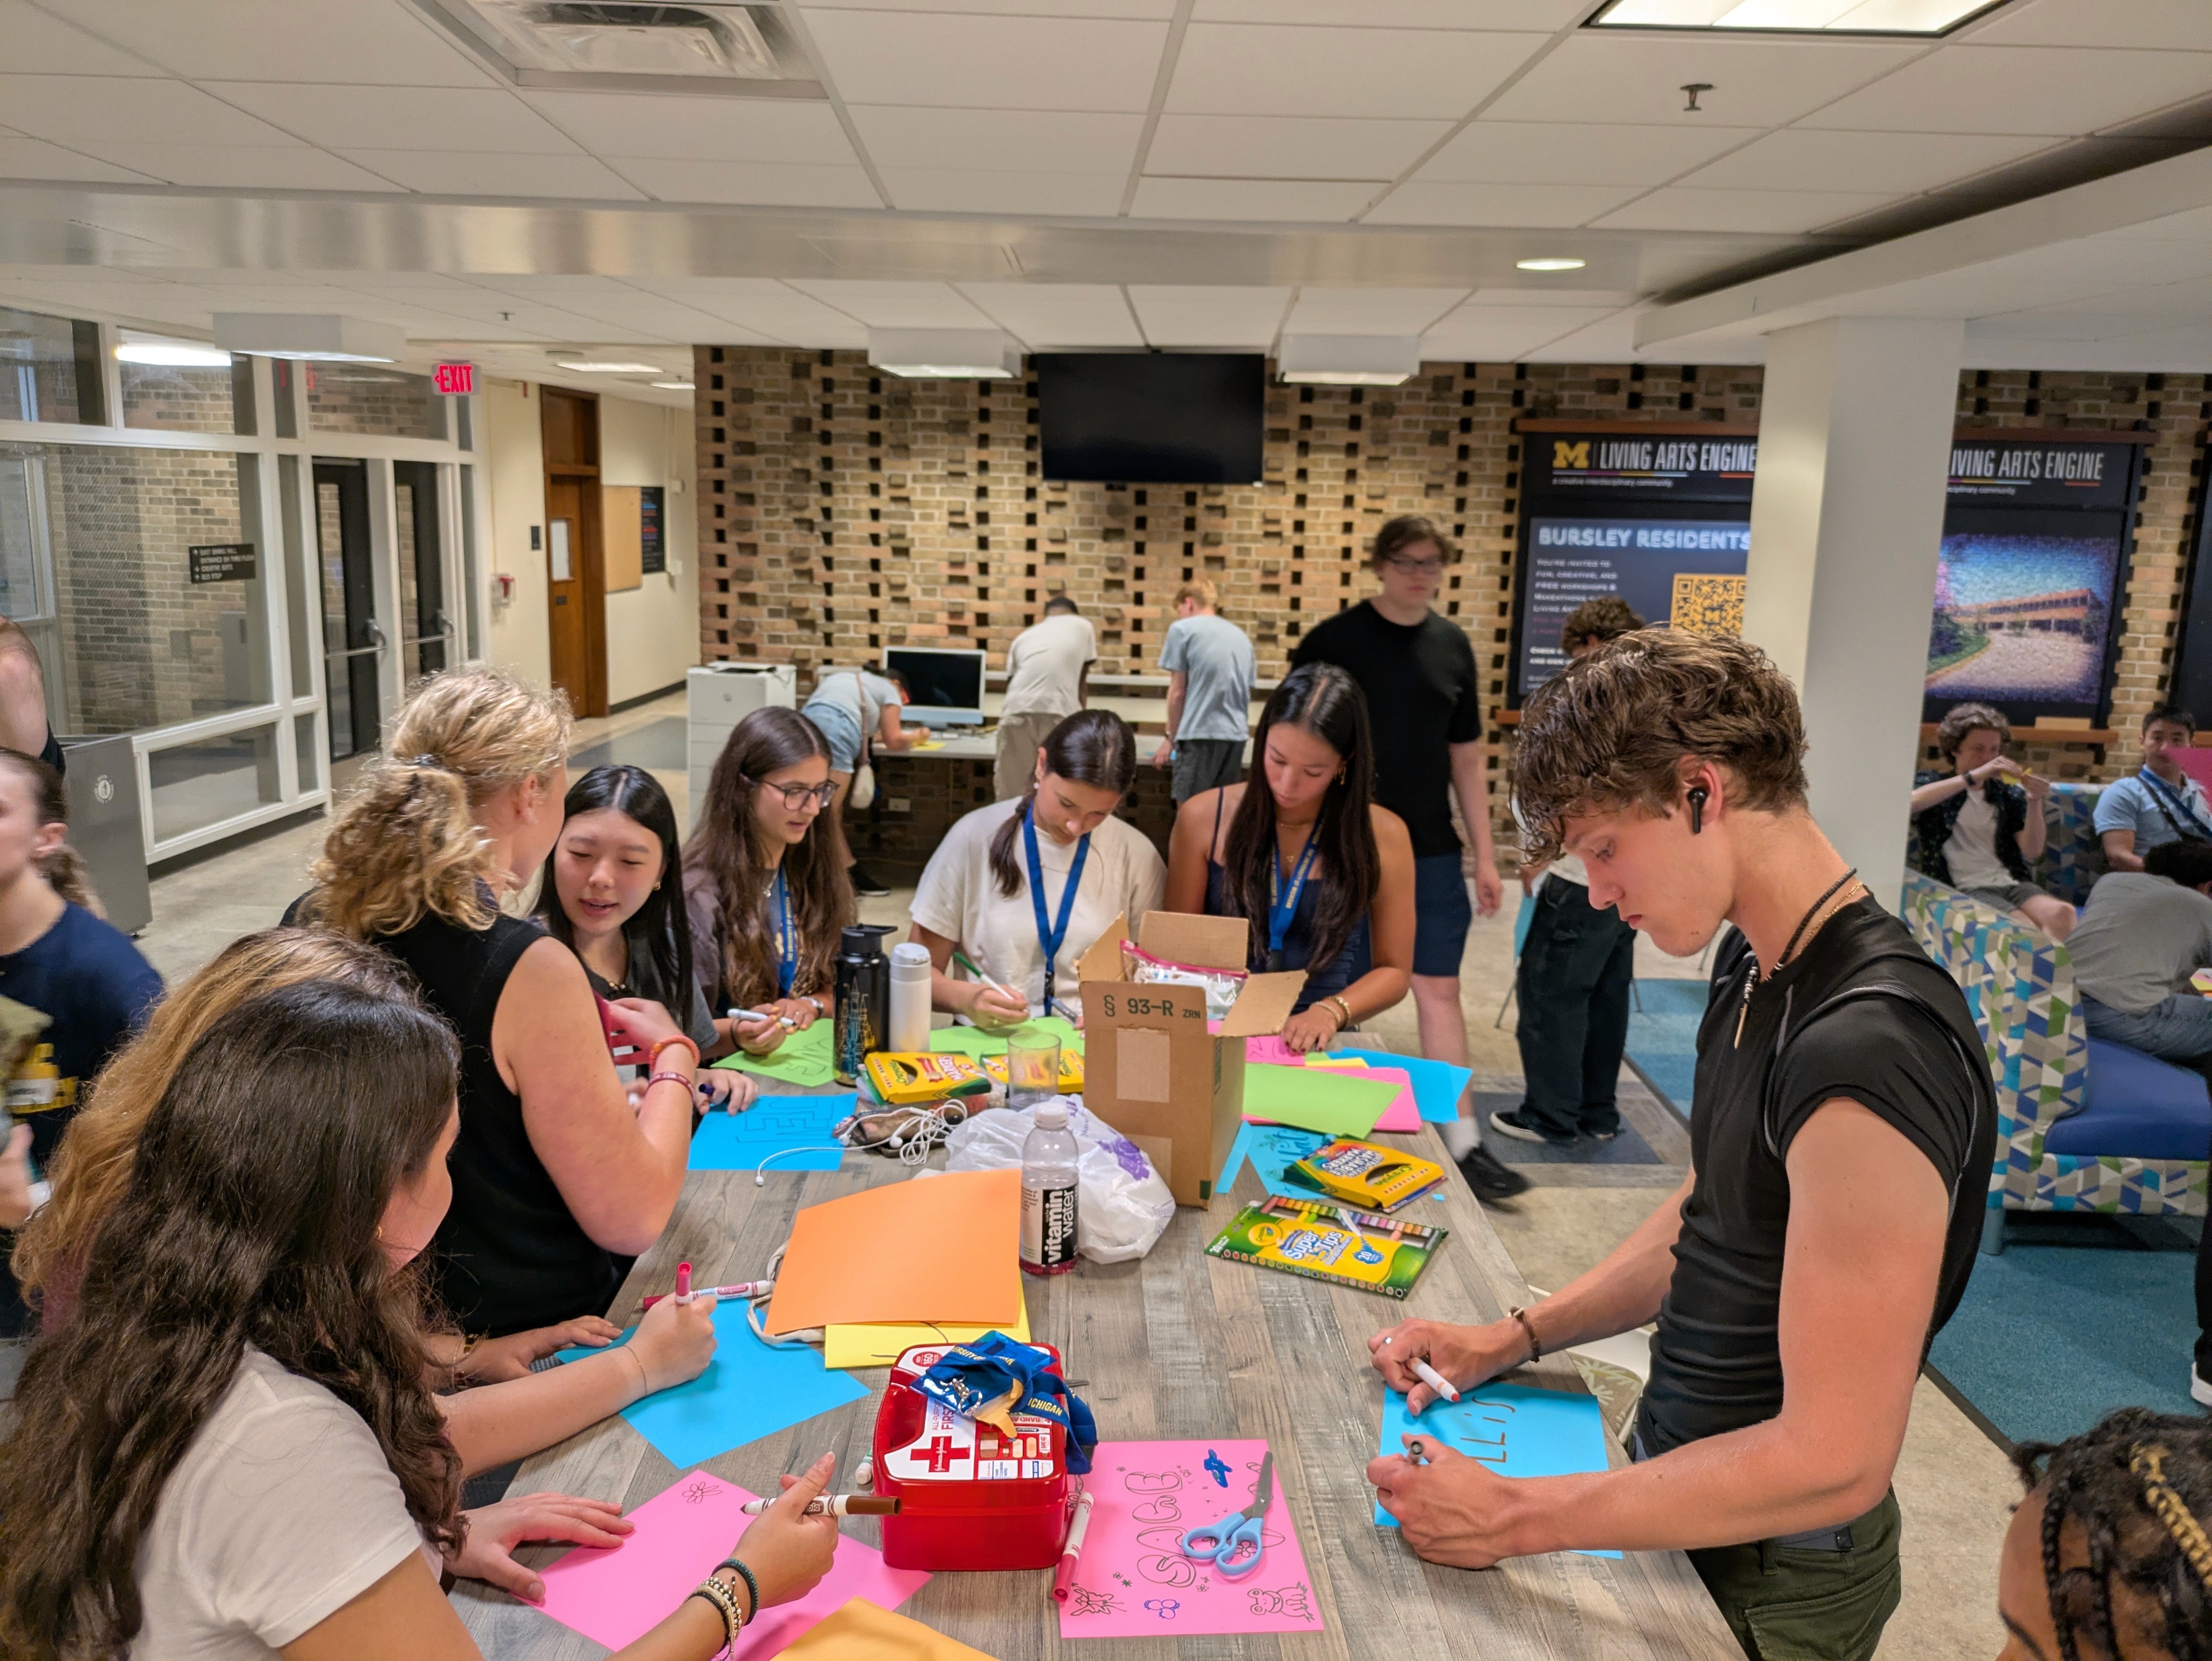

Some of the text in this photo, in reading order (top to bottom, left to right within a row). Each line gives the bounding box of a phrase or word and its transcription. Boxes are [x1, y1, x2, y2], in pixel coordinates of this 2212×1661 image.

[439, 365, 472, 392] EXIT
[1552, 441, 1757, 471] M LIVING ARTS ENGINE
[1950, 449, 2104, 480] IVING ARTS ENGINE
[1538, 526, 1751, 550] BURSLEY RESIDENTS
[1183, 1008, 1201, 1019] ZRN
[1044, 1191, 1062, 1263] vitamin
[1062, 1190, 1074, 1238] water
[1284, 1229, 1318, 1260] Super
[1316, 1230, 1343, 1254] Tips
[1358, 1251, 1371, 1262] 20
[923, 1353, 934, 1365] 160
[932, 1400, 942, 1430] ALL-PURPOS
[1028, 1397, 1062, 1416] ICHIGAN
[1124, 1470, 1196, 1588] SAGE
